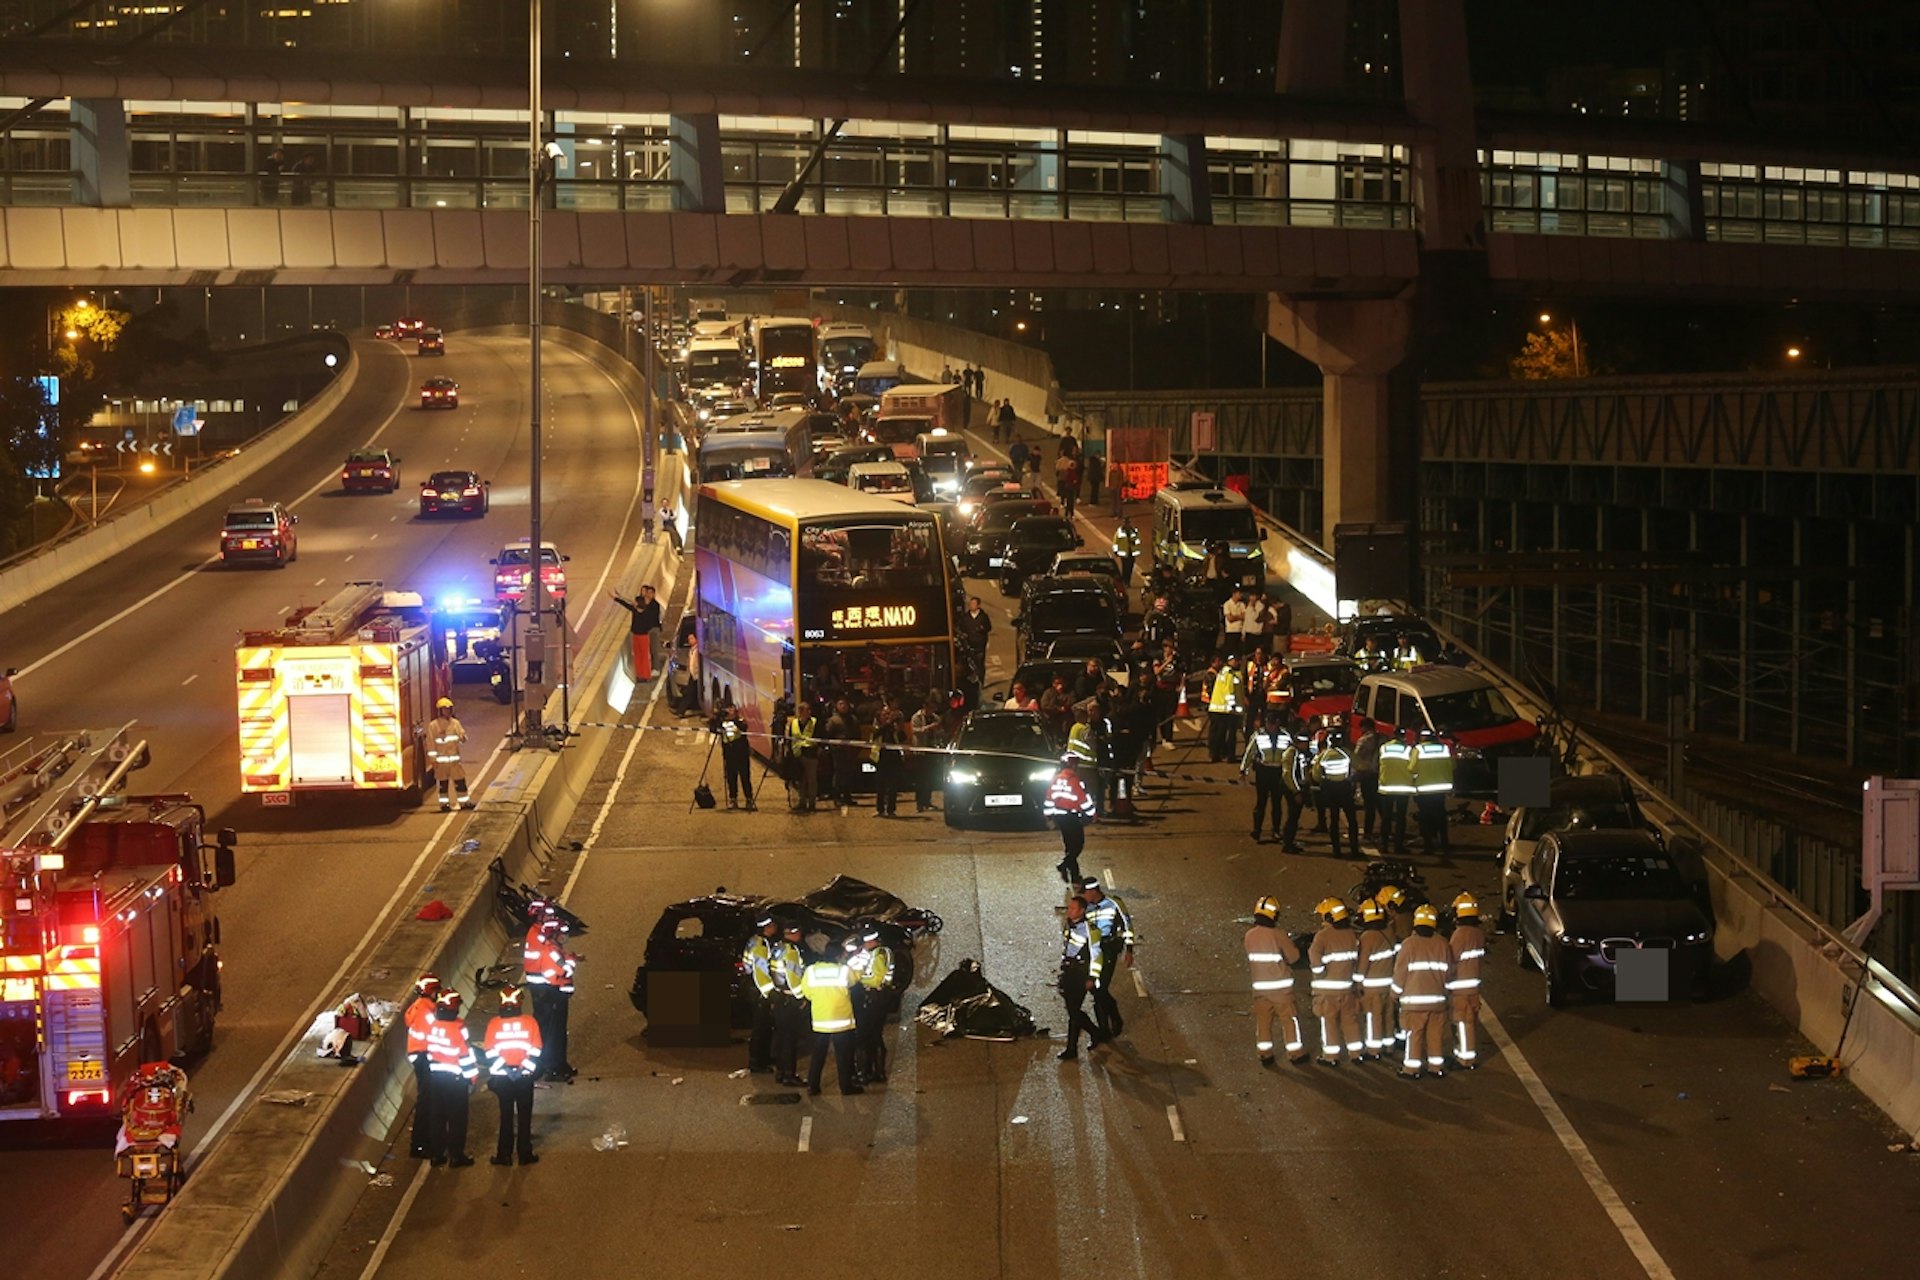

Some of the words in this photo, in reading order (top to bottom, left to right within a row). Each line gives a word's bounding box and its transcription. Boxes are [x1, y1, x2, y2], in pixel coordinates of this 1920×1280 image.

[908, 521, 934, 530] Airport
[883, 605, 916, 627] NA10
[804, 629, 825, 639] 8063
[82, 1061, 89, 1070] F
[71, 1070, 101, 1080] 2324
